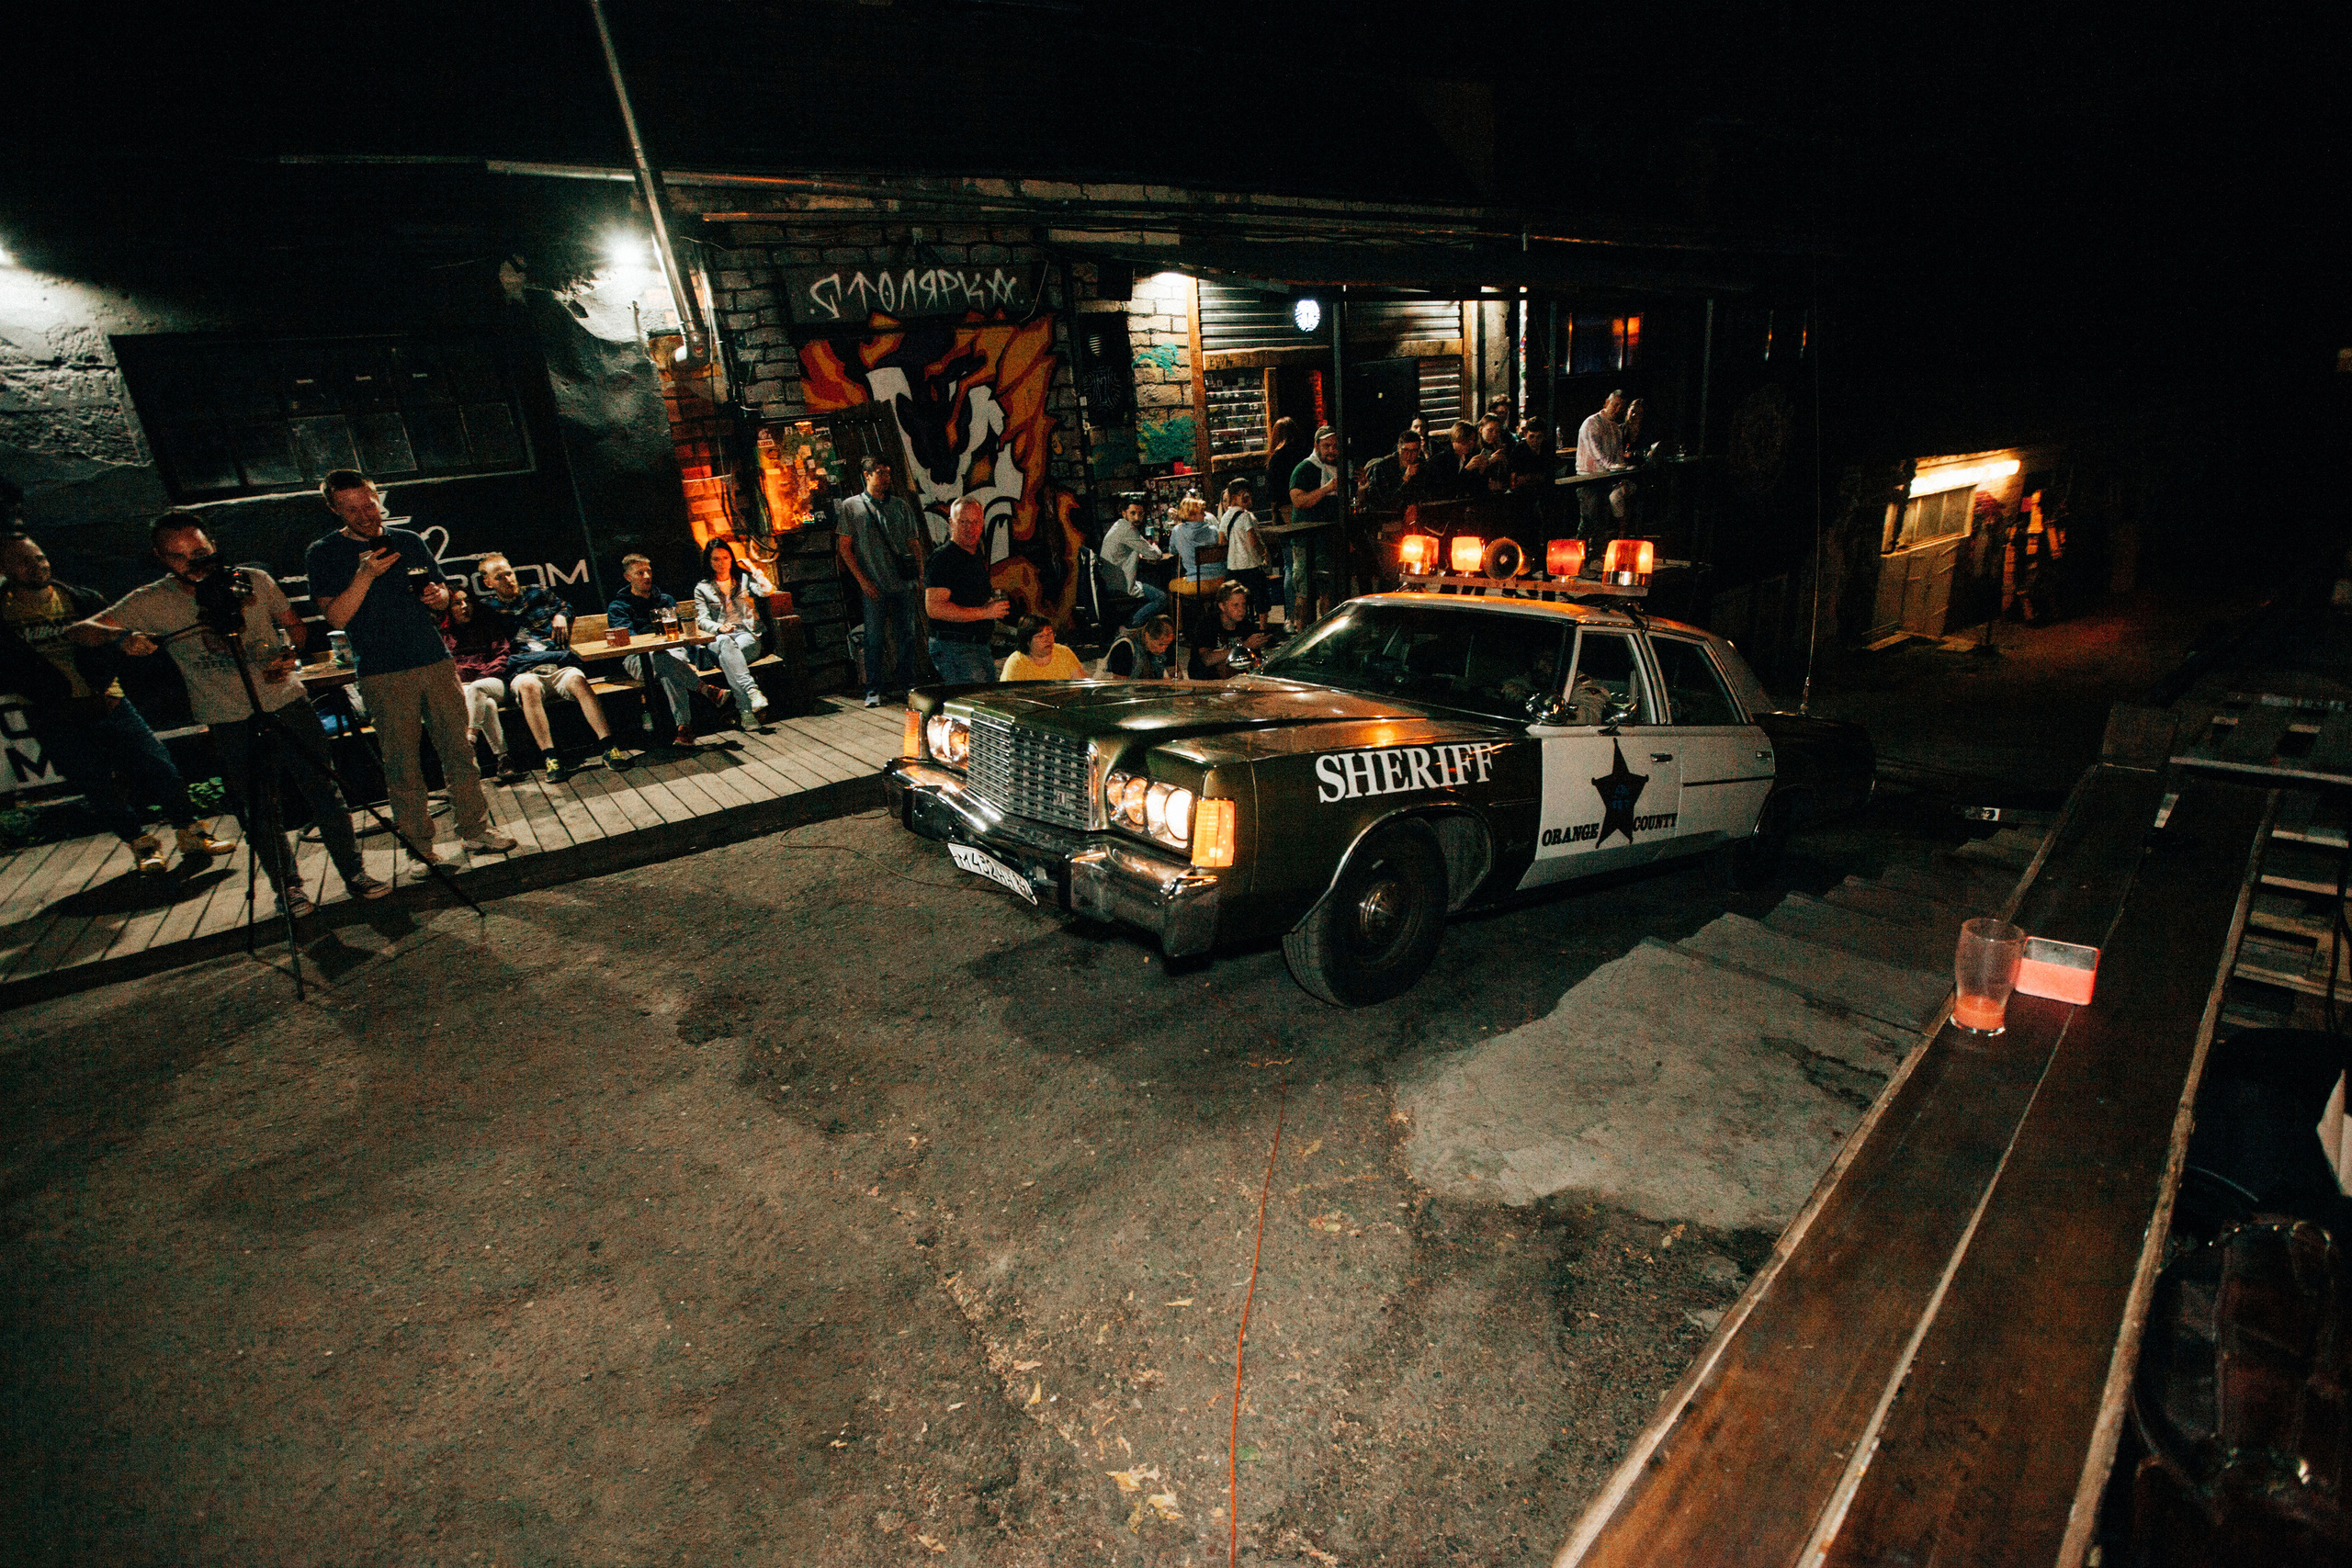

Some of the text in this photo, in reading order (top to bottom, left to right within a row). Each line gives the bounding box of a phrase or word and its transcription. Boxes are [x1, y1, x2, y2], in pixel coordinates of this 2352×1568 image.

[1315, 742, 1493, 804] SHERIFF
[1542, 813, 1678, 846] ORANGE COUNTY
